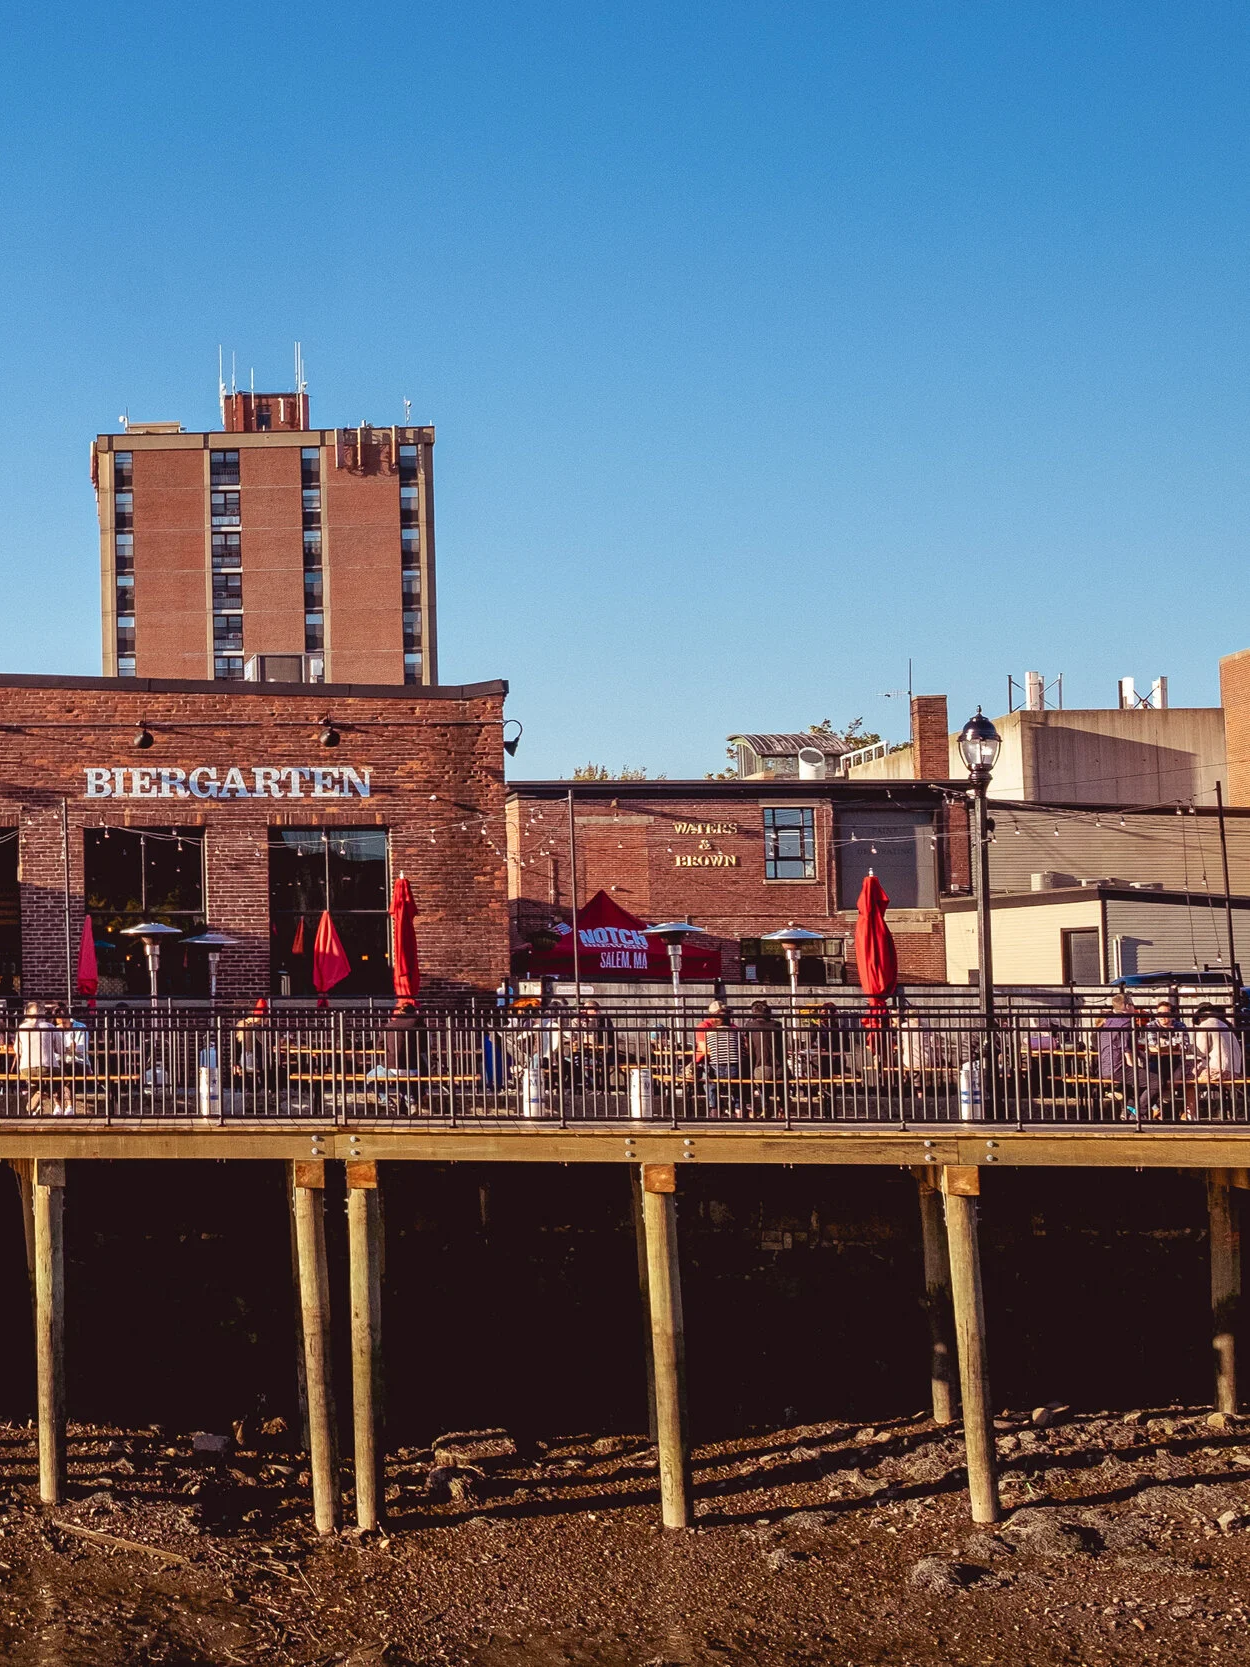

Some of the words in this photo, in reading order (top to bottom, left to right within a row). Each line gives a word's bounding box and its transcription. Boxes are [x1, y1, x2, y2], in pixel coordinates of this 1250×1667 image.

[83, 766, 374, 799] BIERGARTEN
[672, 822, 738, 834] WATERS
[698, 839, 712, 850] &
[674, 854, 737, 867] BROWN
[578, 927, 648, 945] NOTCH
[633, 952, 648, 969] MA
